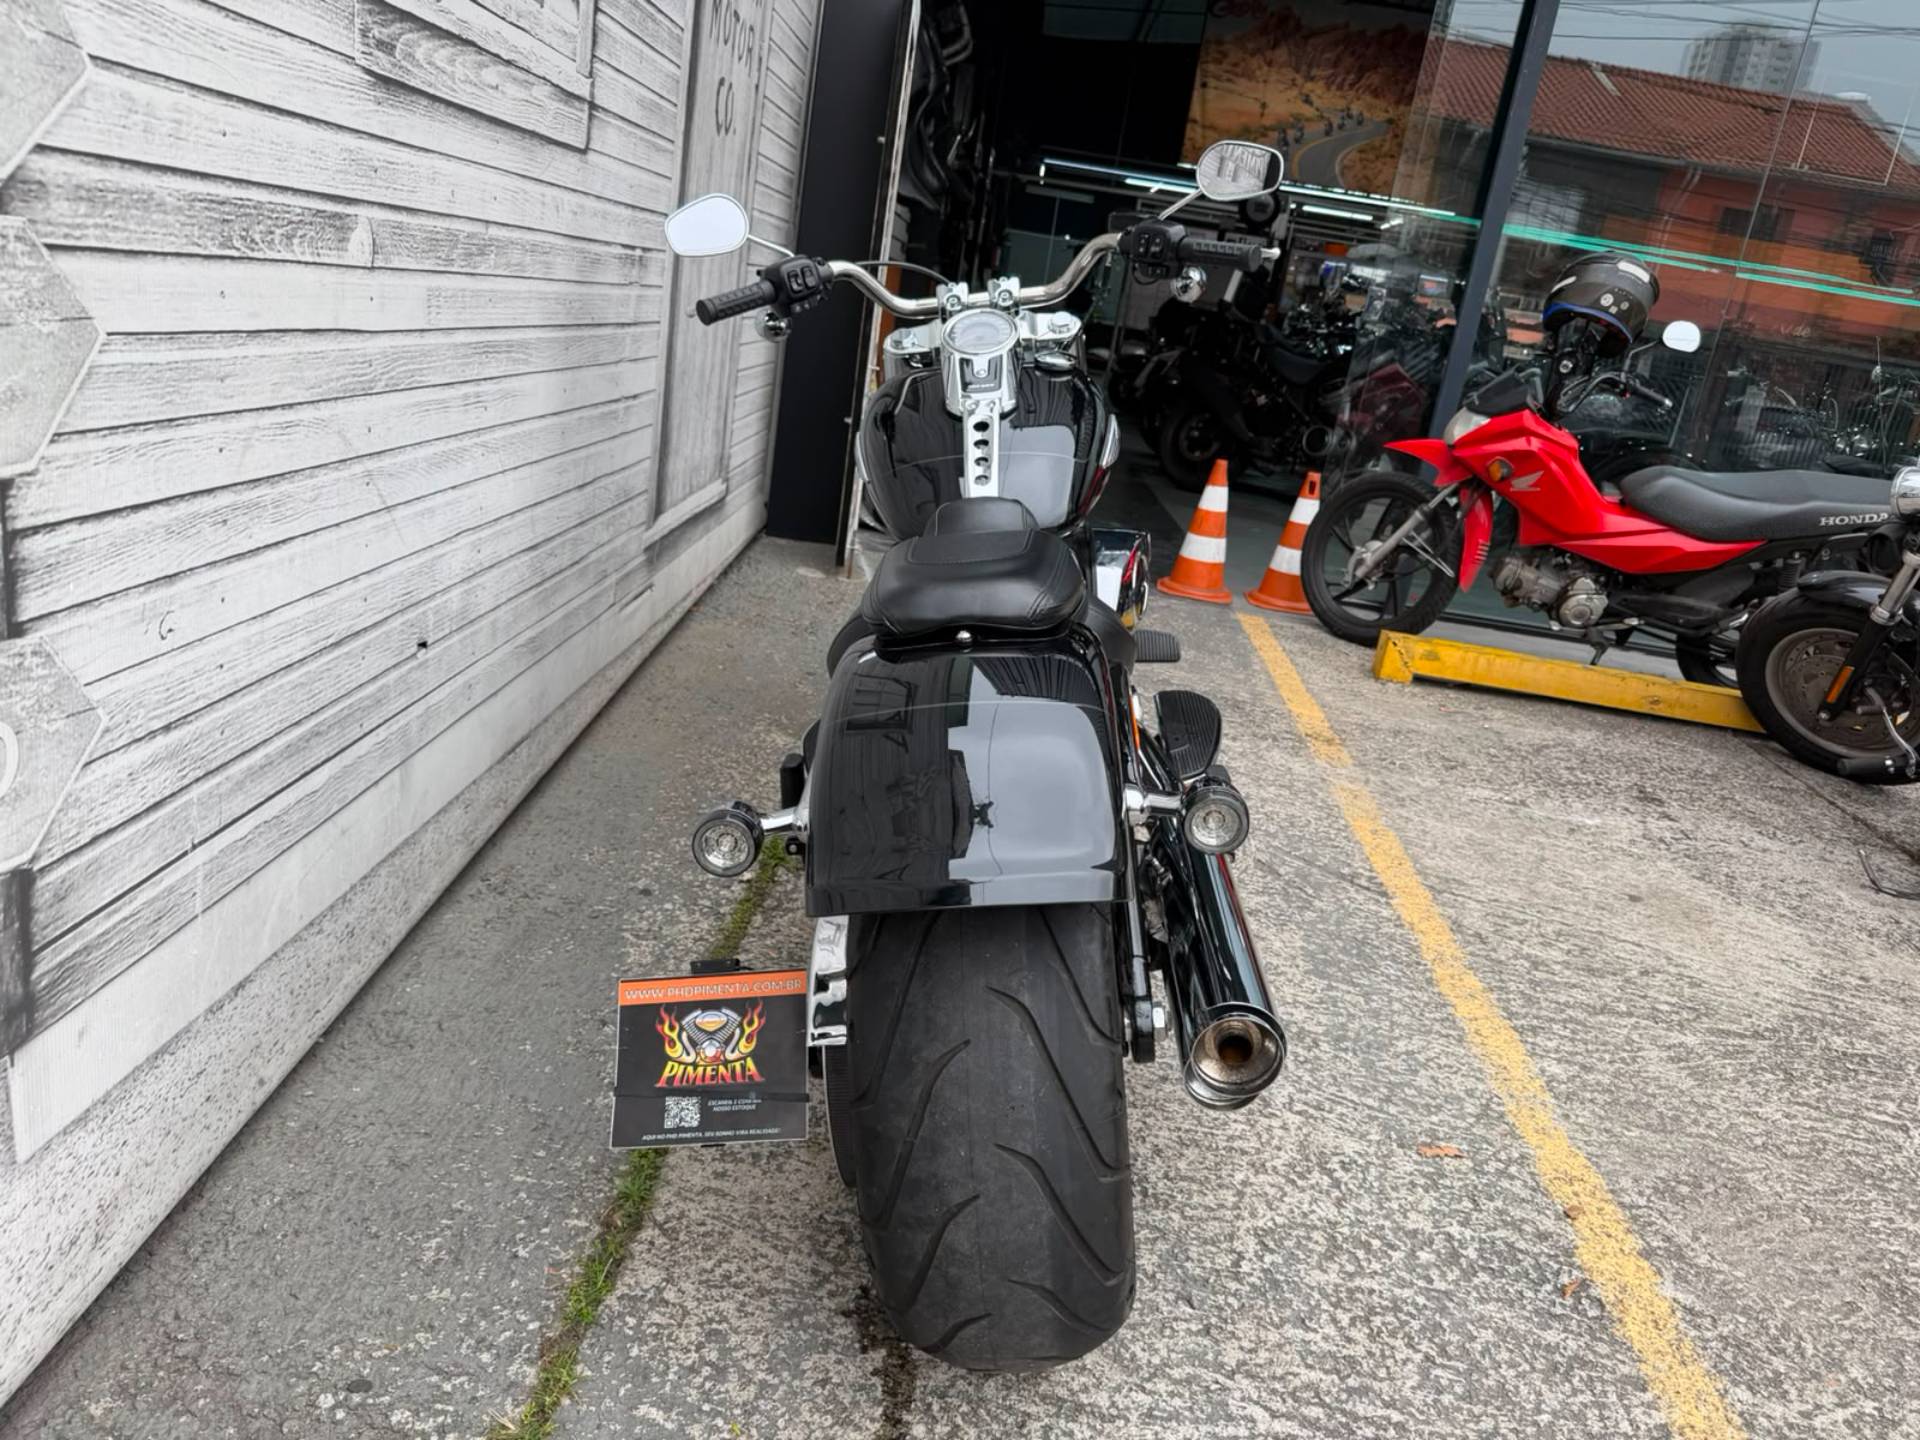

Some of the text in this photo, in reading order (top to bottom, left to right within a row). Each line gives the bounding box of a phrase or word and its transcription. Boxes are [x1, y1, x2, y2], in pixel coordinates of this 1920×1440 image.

[709, 0, 755, 78] MOTOR
[1819, 512, 1889, 526] HONDA
[625, 979, 801, 1000] WWW.PHDPIMENTA.COM.BR
[654, 1057, 765, 1088] PIMENTA
